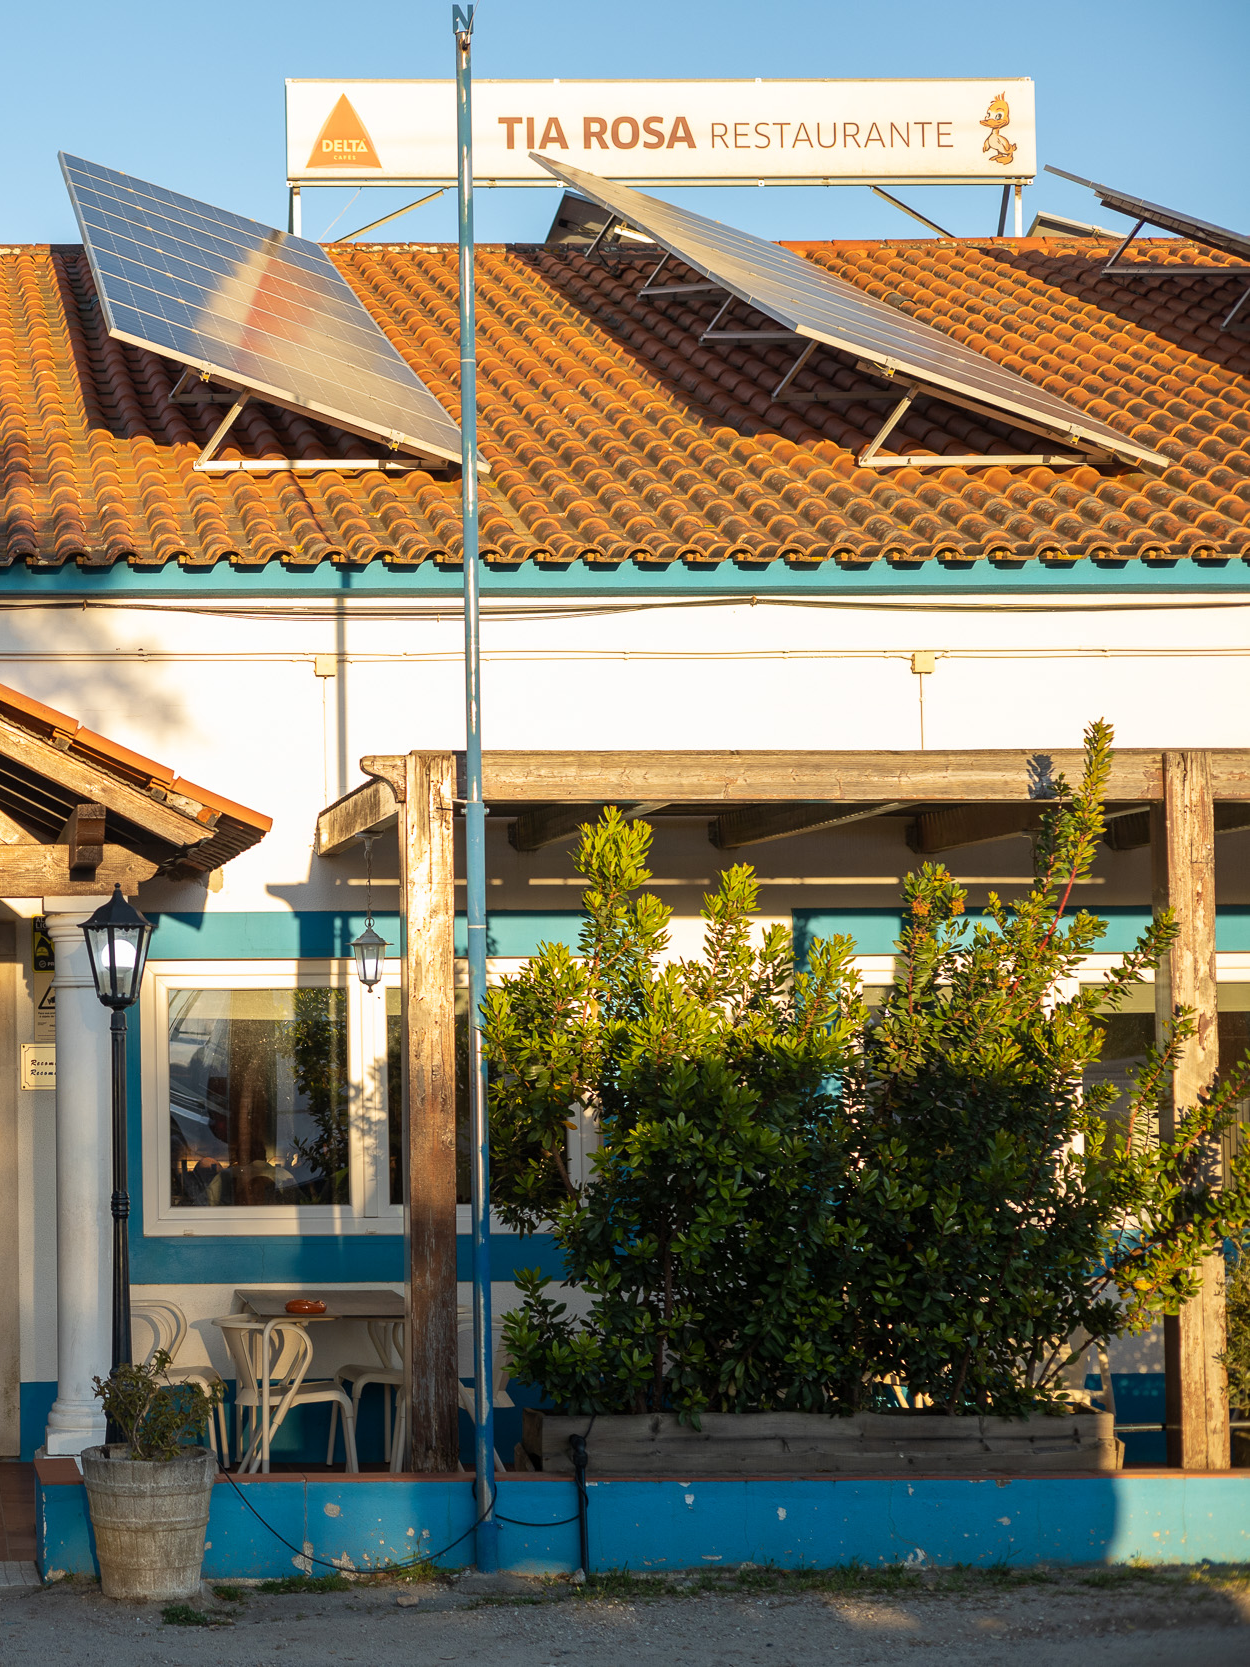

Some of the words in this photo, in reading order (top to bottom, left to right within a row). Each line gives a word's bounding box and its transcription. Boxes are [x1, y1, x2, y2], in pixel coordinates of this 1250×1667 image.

[497, 116, 570, 150] TIA
[582, 115, 698, 150] ROSA
[710, 121, 954, 149] RESTAURANTE
[321, 138, 369, 153] DELTA
